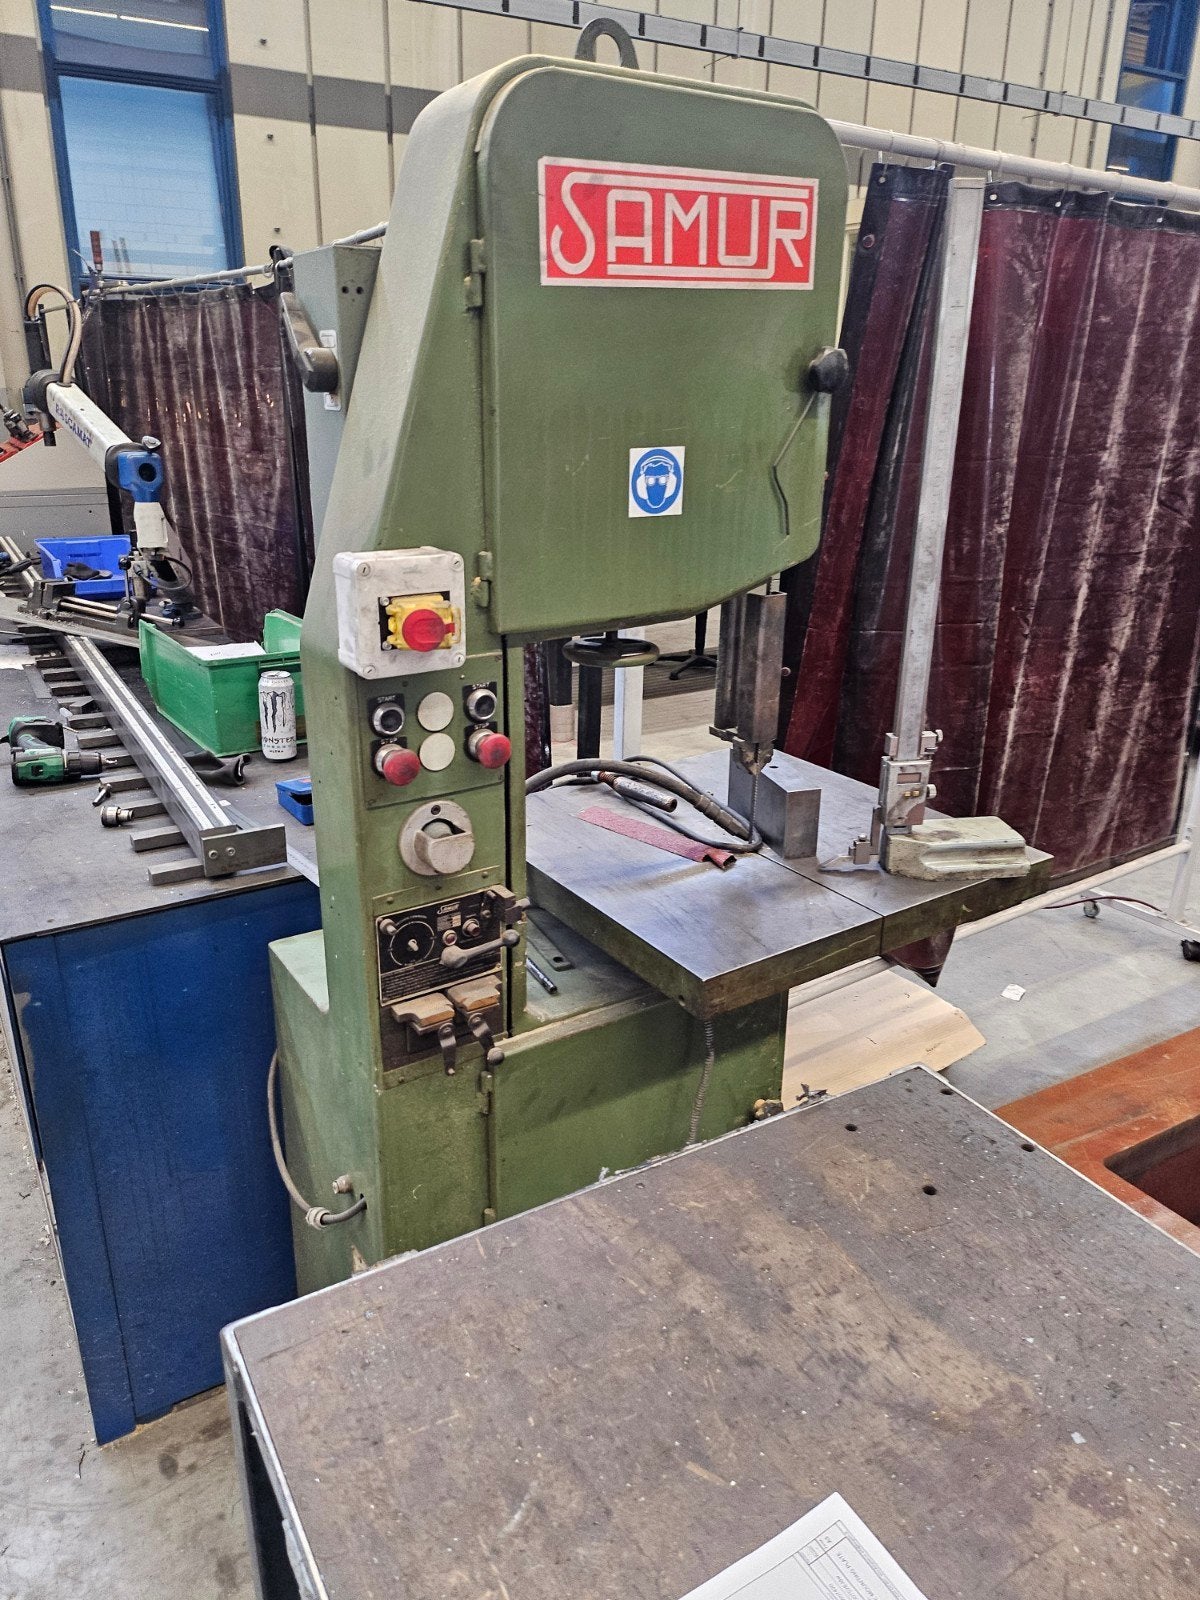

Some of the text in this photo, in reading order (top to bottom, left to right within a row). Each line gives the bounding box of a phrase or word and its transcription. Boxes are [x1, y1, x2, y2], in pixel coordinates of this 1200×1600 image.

[550, 171, 810, 279] SAMUR
[472, 682, 490, 690] START
[377, 695, 396, 703] START
[474, 722, 490, 730] STOP
[380, 737, 398, 745] STOP
